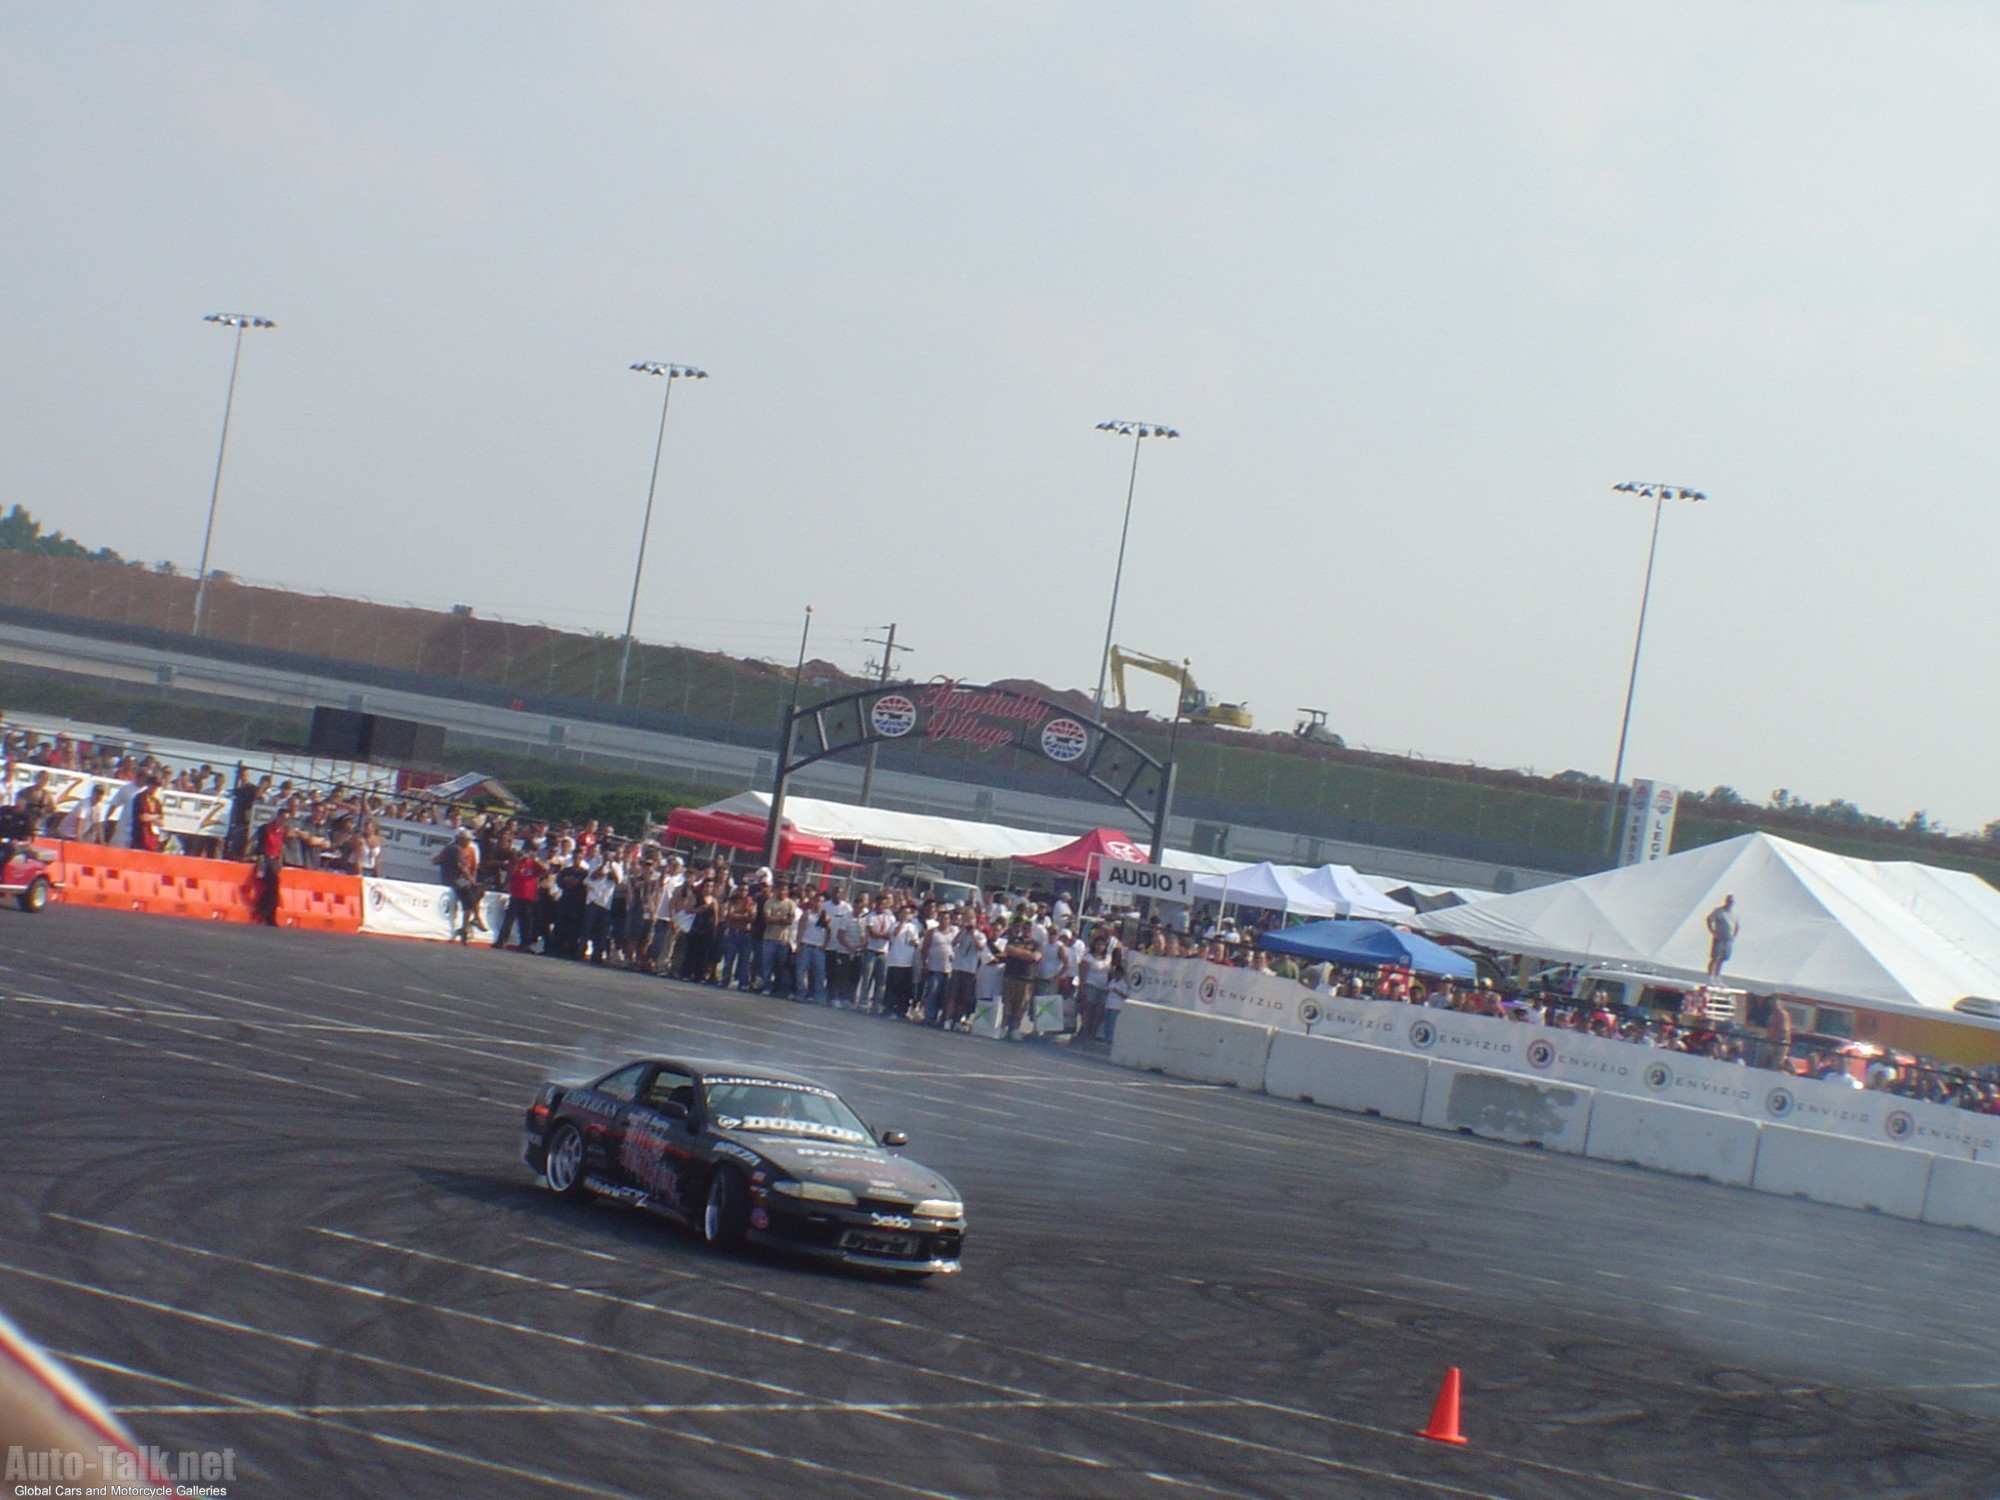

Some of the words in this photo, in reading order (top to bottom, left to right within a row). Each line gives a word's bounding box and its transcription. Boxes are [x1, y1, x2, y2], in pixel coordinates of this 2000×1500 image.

[918, 674, 1050, 729] Hospitality
[926, 711, 1014, 752] Village
[1108, 866, 1172, 892] AUDIO
[1178, 877, 1188, 895] 1
[1218, 990, 1284, 1011] ENVIZIO
[1325, 1012, 1393, 1032] ENVIZIO
[1438, 1033, 1511, 1053] ENVIZIO
[1557, 1054, 1628, 1076] ENVIZIO
[1675, 1077, 1750, 1100] ENVIZIO
[1796, 1101, 1870, 1124] ENVIZIO
[1917, 1125, 1993, 1149] ENVIZIO
